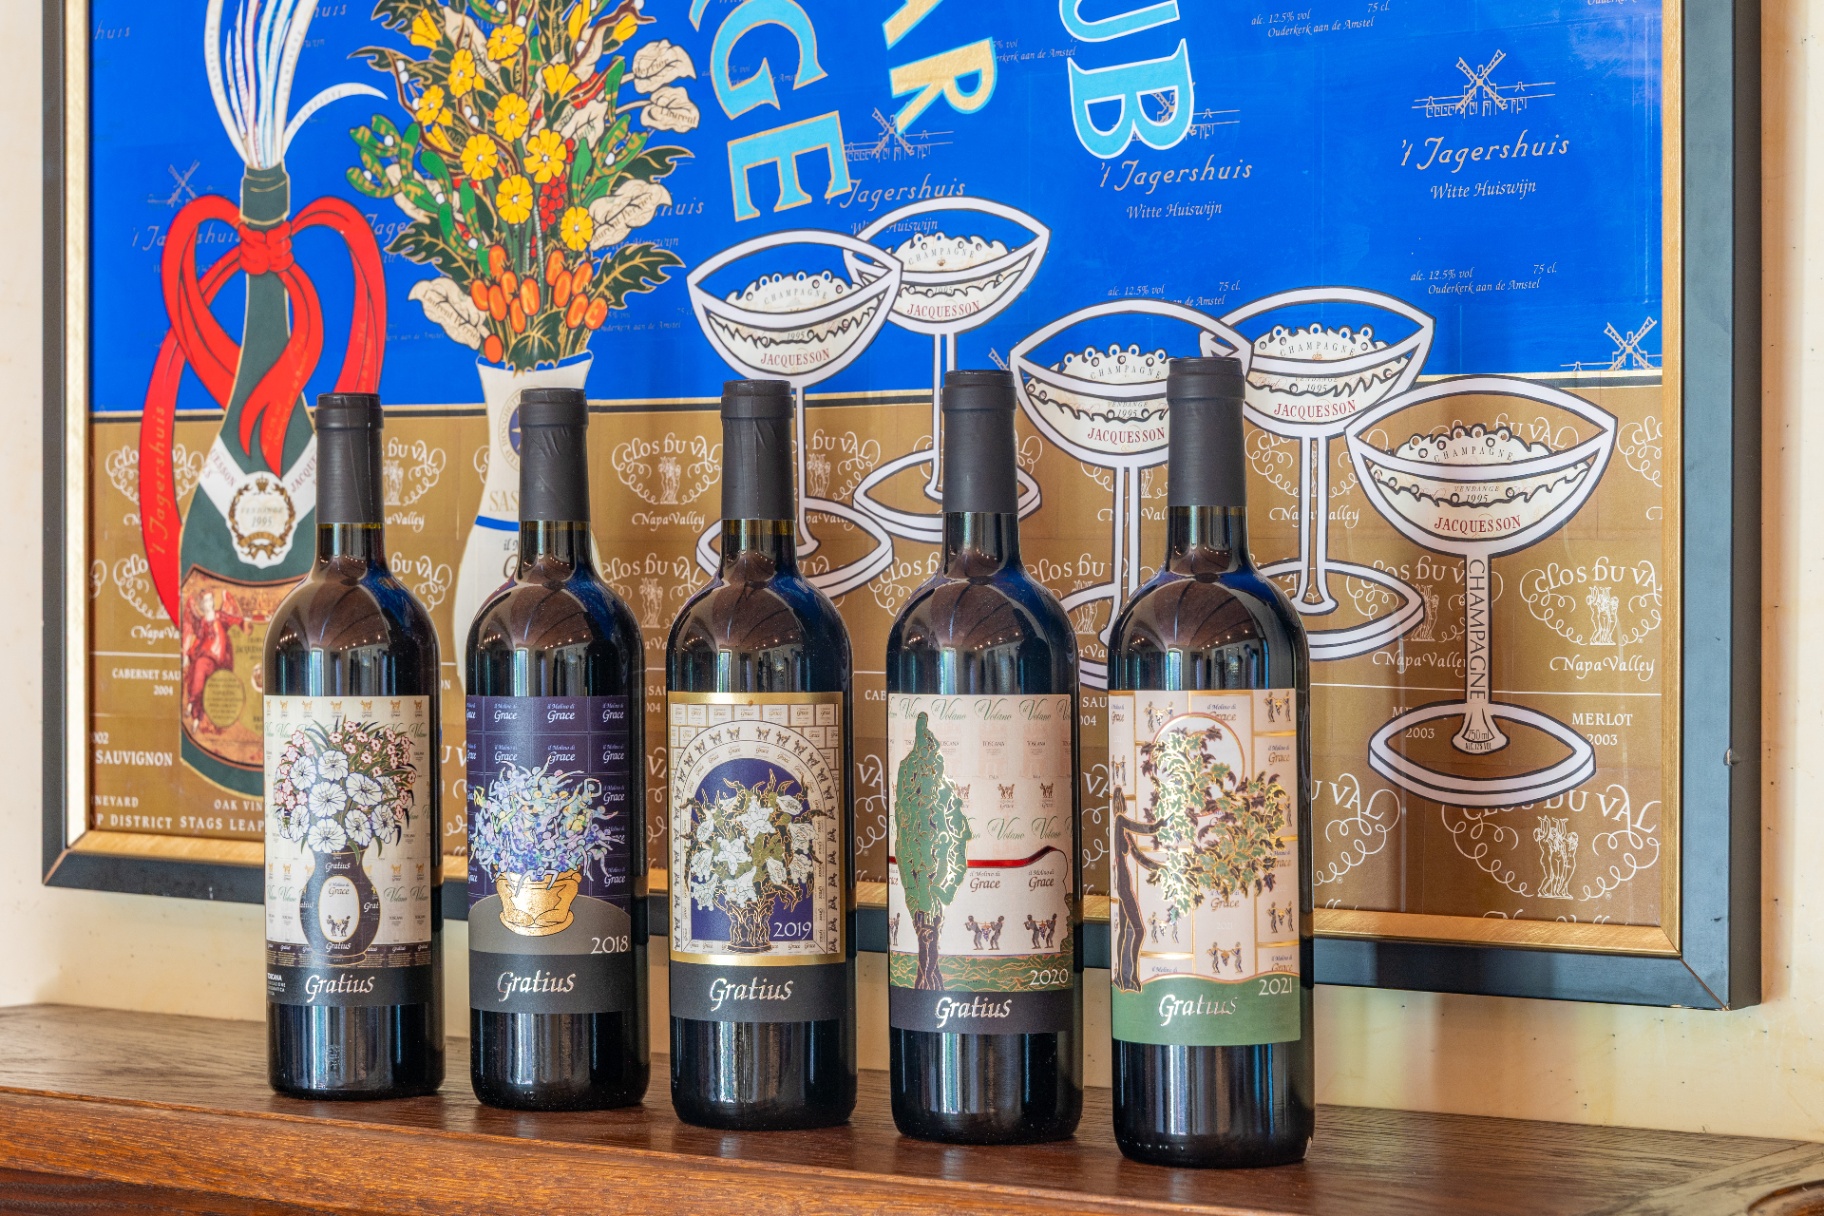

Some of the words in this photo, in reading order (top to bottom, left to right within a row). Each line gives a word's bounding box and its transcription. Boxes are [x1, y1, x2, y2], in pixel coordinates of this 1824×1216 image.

[1268, 12, 1295, 24] 12.5%
[1297, 8, 1312, 21] vol
[1367, 2, 1379, 13] 75
[1267, 22, 1313, 38] Ouderkerk
[1313, 23, 1329, 33] aan
[1331, 20, 1342, 31] de
[1343, 16, 1376, 30] Amstel
[1048, 46, 1077, 58] Amstel
[689, 0, 853, 222] GE
[1416, 129, 1570, 174] Jagershuis
[1113, 154, 1253, 195] Jagershuis
[840, 173, 966, 212] Jagershuis
[1430, 182, 1470, 200] Witte
[1473, 178, 1537, 200] Huiswijn
[1126, 203, 1162, 219] Witte
[1165, 201, 1223, 221] Huiswijn
[908, 247, 975, 265] CHAMPAGNE
[1428, 269, 1456, 280] 12.5%
[1459, 267, 1475, 278] vol
[1533, 264, 1545, 275] 75
[1124, 285, 1149, 296] 12.5%
[1151, 284, 1165, 295] vol
[1218, 282, 1229, 292] 75
[1428, 281, 1475, 295] Ouderkerk
[1475, 283, 1493, 291] aan
[1495, 280, 1506, 291] de
[1507, 277, 1541, 291] Amstel
[764, 288, 828, 305] CHAMPAGNE
[1196, 294, 1227, 306] Amstel
[906, 300, 981, 319] JACQUESSON
[787, 331, 805, 340] 1995
[760, 348, 831, 368] JACQUESSON
[1280, 341, 1356, 357] CHAMPAGNE
[1090, 365, 1162, 380] CHAMPAGNE
[1306, 384, 1328, 393] 1995
[1117, 408, 1138, 418] 1995
[1274, 400, 1356, 420] JACQUESSON
[1087, 427, 1166, 445] JACQUESSON
[411, 439, 439, 468] VAL
[623, 437, 660, 464] CLOS
[663, 432, 685, 455] DU
[689, 435, 719, 465] VAL
[840, 431, 872, 461] VAL
[1434, 446, 1514, 463] CHAMPAGNE
[1466, 494, 1489, 503] 1995
[251, 516, 273, 528] 1995
[390, 511, 425, 533] Valley
[631, 511, 670, 533] Napa
[669, 510, 705, 533] Valley
[1329, 505, 1360, 529] alley
[1434, 515, 1521, 535] JACQUESSON
[415, 555, 445, 585] VAL
[644, 552, 668, 576] DU
[672, 556, 703, 587] VAL
[1077, 553, 1106, 578] DU
[1535, 561, 1587, 595] CLOS
[1591, 556, 1627, 583] DU
[1468, 559, 1486, 700] CHAMPAGNE
[112, 668, 160, 681] CABERNET
[1550, 655, 1604, 680] Napa
[1602, 654, 1655, 681] Valley
[153, 685, 174, 697] 2004
[494, 709, 517, 723] Grace
[547, 710, 576, 723] Grace
[602, 709, 624, 722] Grace
[931, 697, 967, 721] Volano
[975, 697, 1012, 721] Volano
[1019, 698, 1052, 721] Volano
[1571, 712, 1633, 727] MERLOT
[1405, 727, 1435, 740] 2003
[1587, 733, 1618, 746] 2003
[96, 750, 173, 767] SAUVIGNON
[494, 751, 518, 764] Grace
[549, 751, 576, 764] Grace
[602, 750, 624, 764] Grace
[1268, 752, 1291, 765] Grace
[214, 799, 238, 811] OAK
[603, 792, 625, 805] Grace
[1329, 773, 1386, 822] VAL
[1596, 784, 1662, 834] VAL
[110, 814, 173, 829] DISTRICT
[180, 816, 223, 830] STAGS
[987, 817, 1025, 841] Volano
[1031, 816, 1062, 840] Volano
[325, 861, 351, 873] Gratius
[603, 874, 626, 887] Grace
[970, 877, 1001, 893] Grace
[1028, 876, 1054, 891] Grace
[328, 887, 350, 898] Grace
[1210, 897, 1240, 912] Grace
[773, 921, 812, 941] 2019
[325, 941, 352, 952] Gratius
[590, 935, 629, 954] 2018
[497, 969, 577, 1002] Gratius
[1030, 968, 1069, 986] 2020
[305, 973, 375, 1003] Gratius
[709, 976, 794, 1012] Gratius
[1258, 977, 1293, 996] 2021
[935, 995, 1013, 1029] Gratius
[1158, 994, 1238, 1027] Gratius
